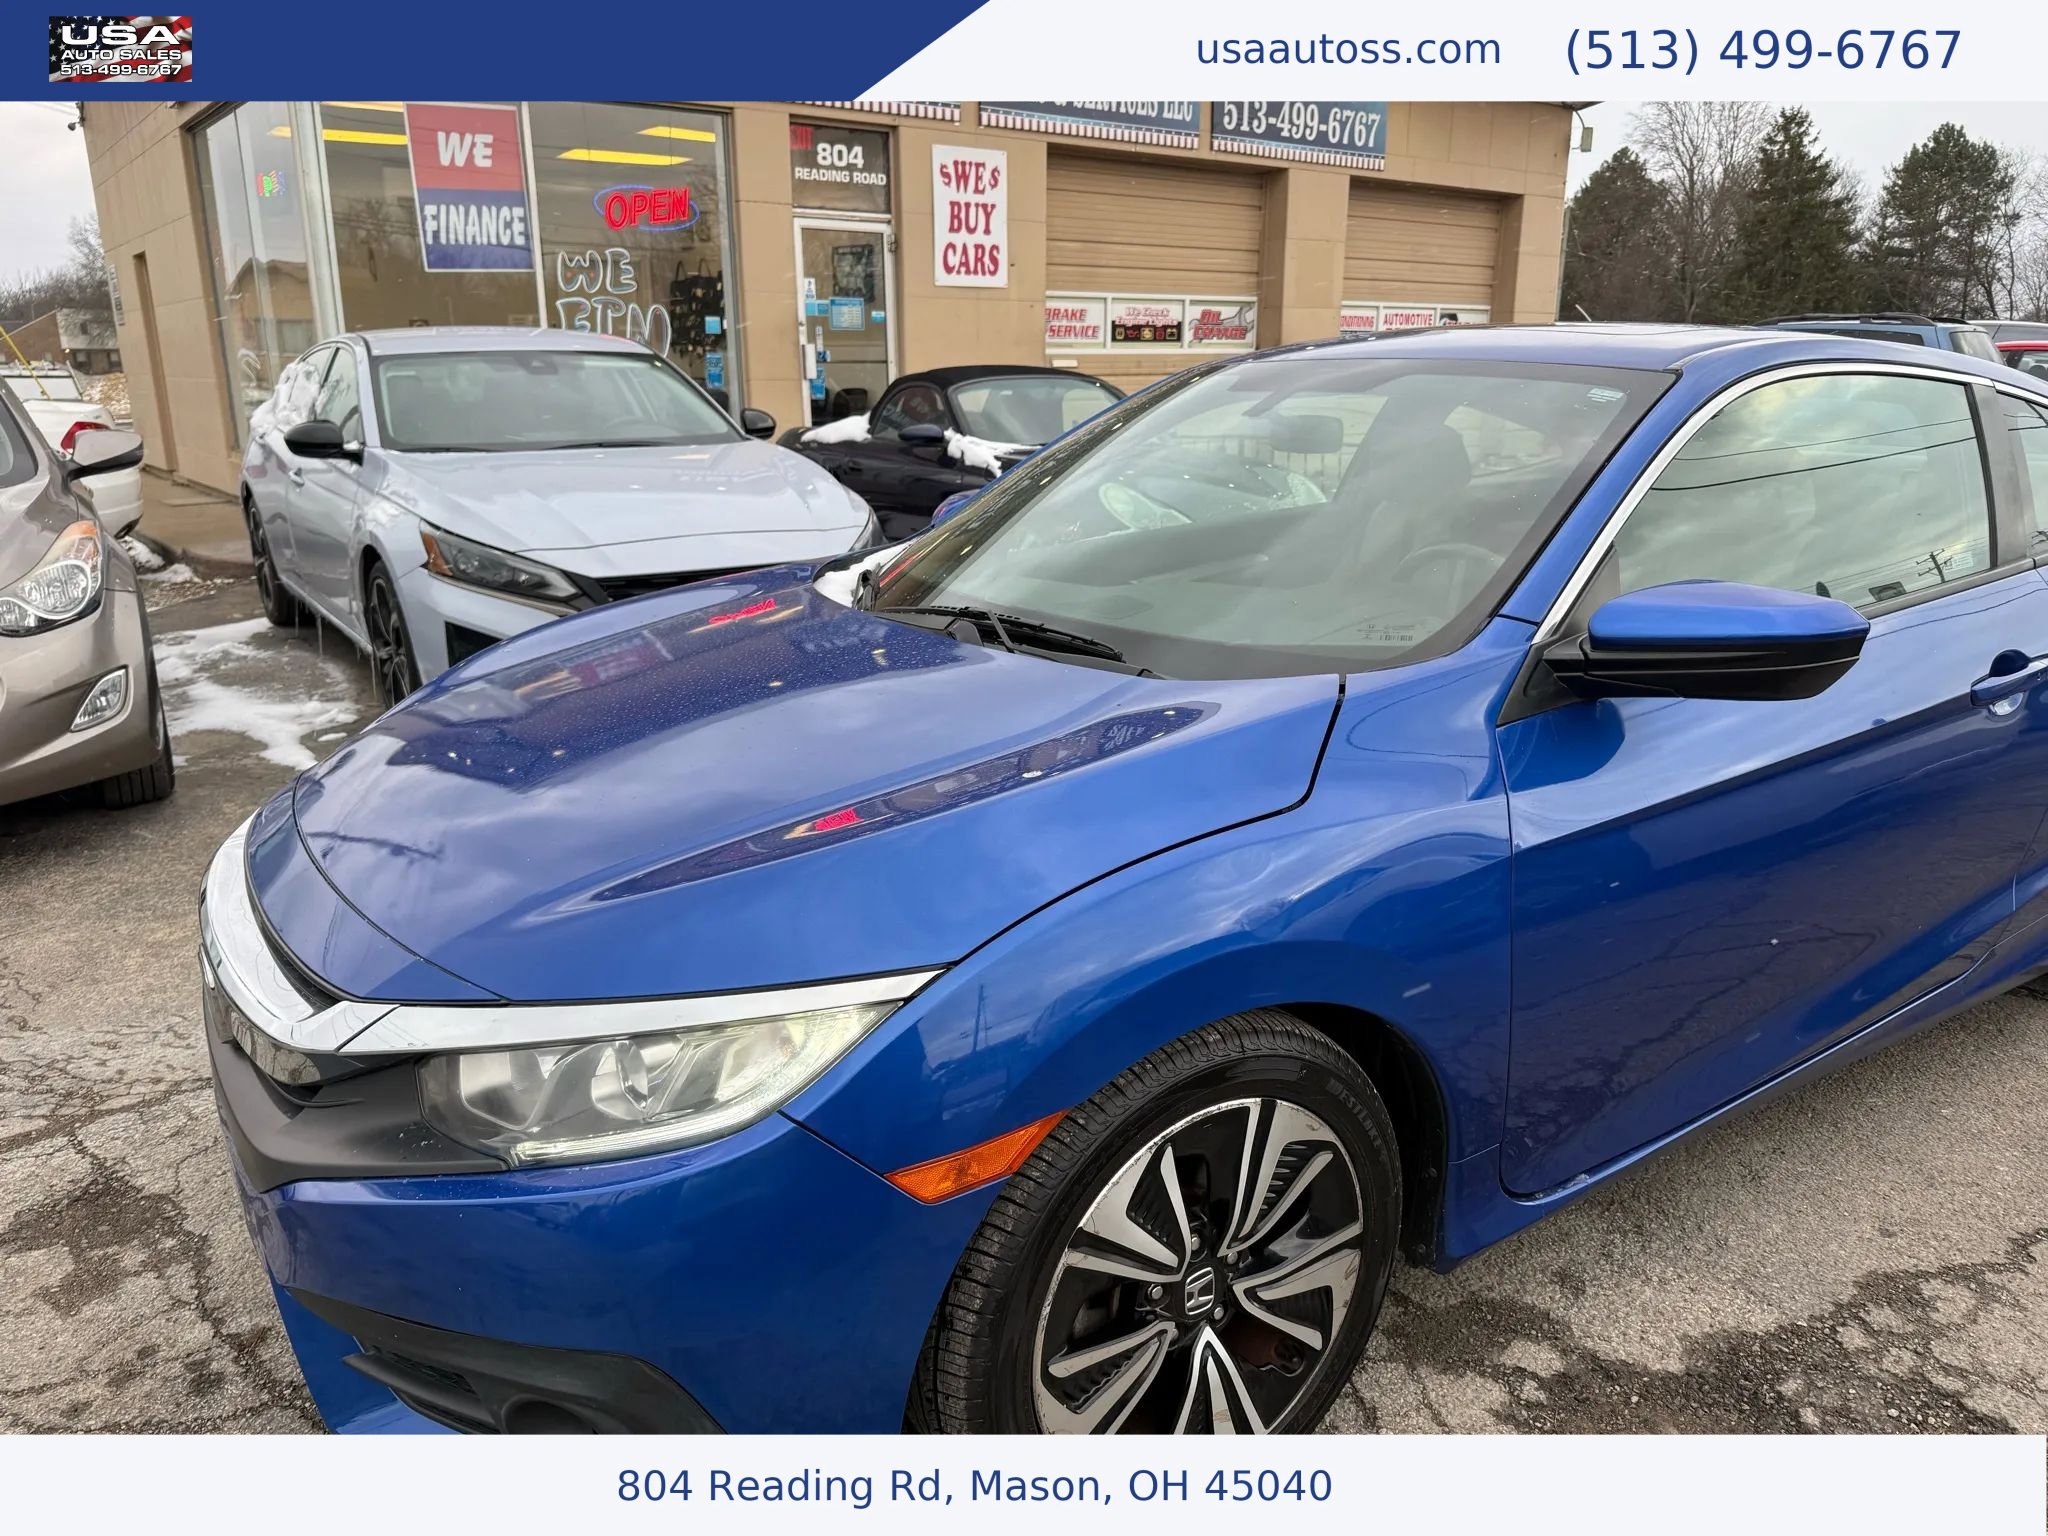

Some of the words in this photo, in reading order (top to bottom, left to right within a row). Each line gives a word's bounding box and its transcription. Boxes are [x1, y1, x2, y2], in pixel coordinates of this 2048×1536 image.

[1223, 100, 1380, 148] 513-499-6767
[437, 131, 493, 167] WE
[816, 142, 864, 169] 804
[794, 167, 850, 183] READING
[852, 171, 887, 186] ROAD
[424, 203, 526, 246] FINANCE
[604, 186, 690, 231] OPEN
[949, 201, 996, 235] BUY
[557, 247, 638, 294] WE
[943, 242, 1000, 276] CARS
[1048, 324, 1100, 339] SERVICE
[1383, 312, 1433, 327] AUTOMOTIVE
